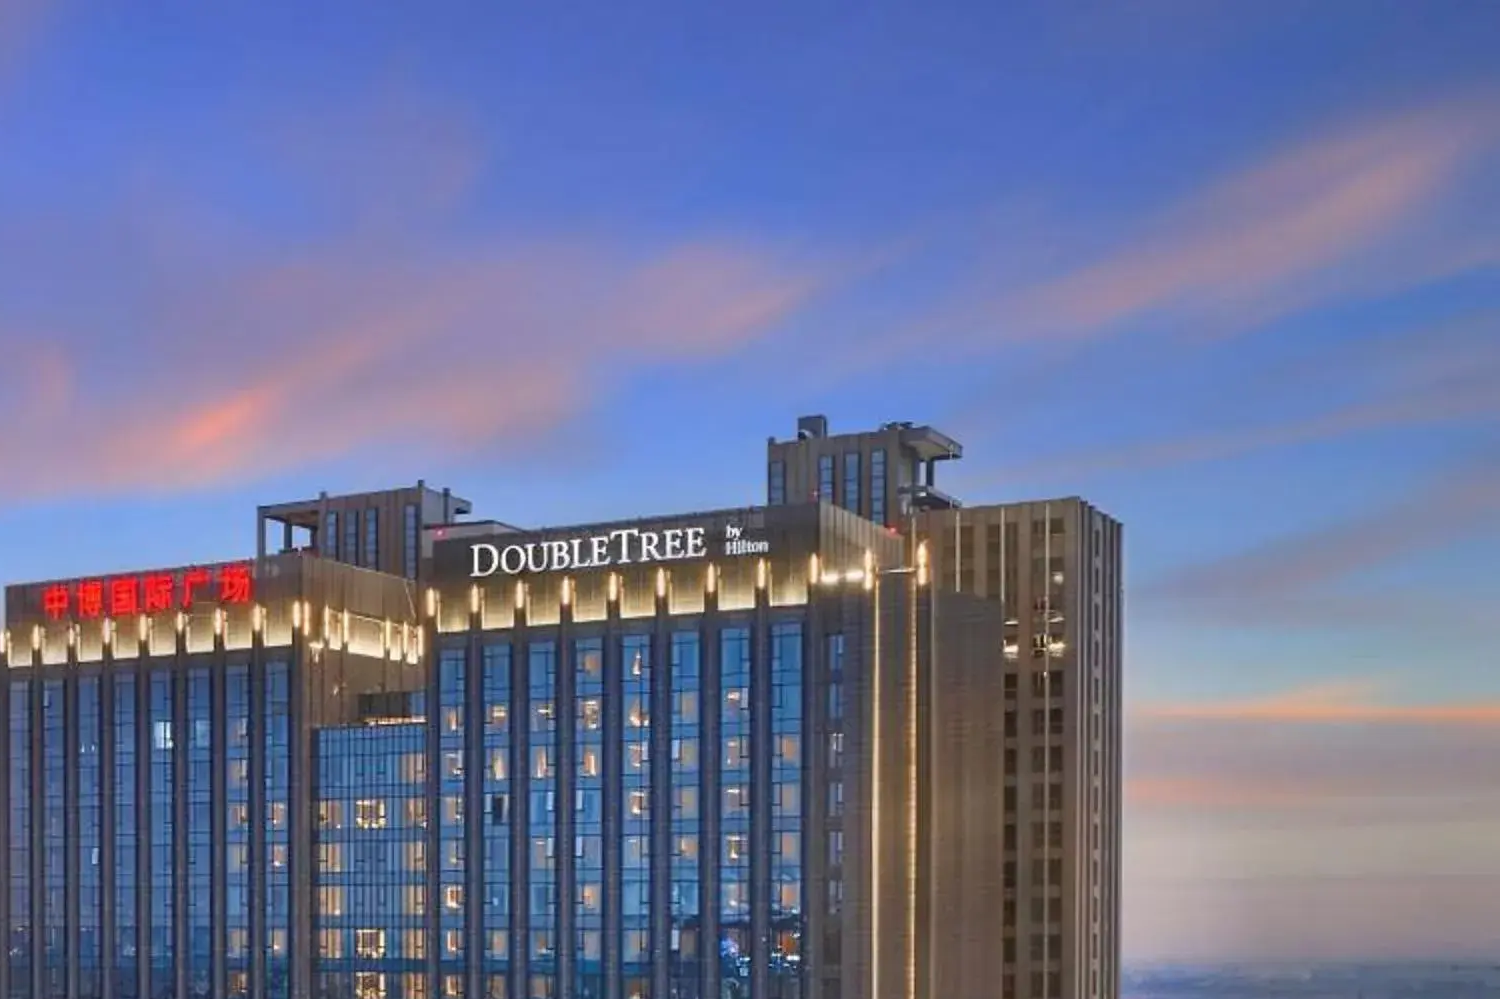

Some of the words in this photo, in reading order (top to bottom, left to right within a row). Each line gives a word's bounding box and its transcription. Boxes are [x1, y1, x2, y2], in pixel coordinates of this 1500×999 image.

[725, 539, 769, 555] Hilton
[726, 524, 743, 540] by
[470, 527, 707, 577] DOUBLETREE
[43, 563, 253, 619] 中博国际广场
